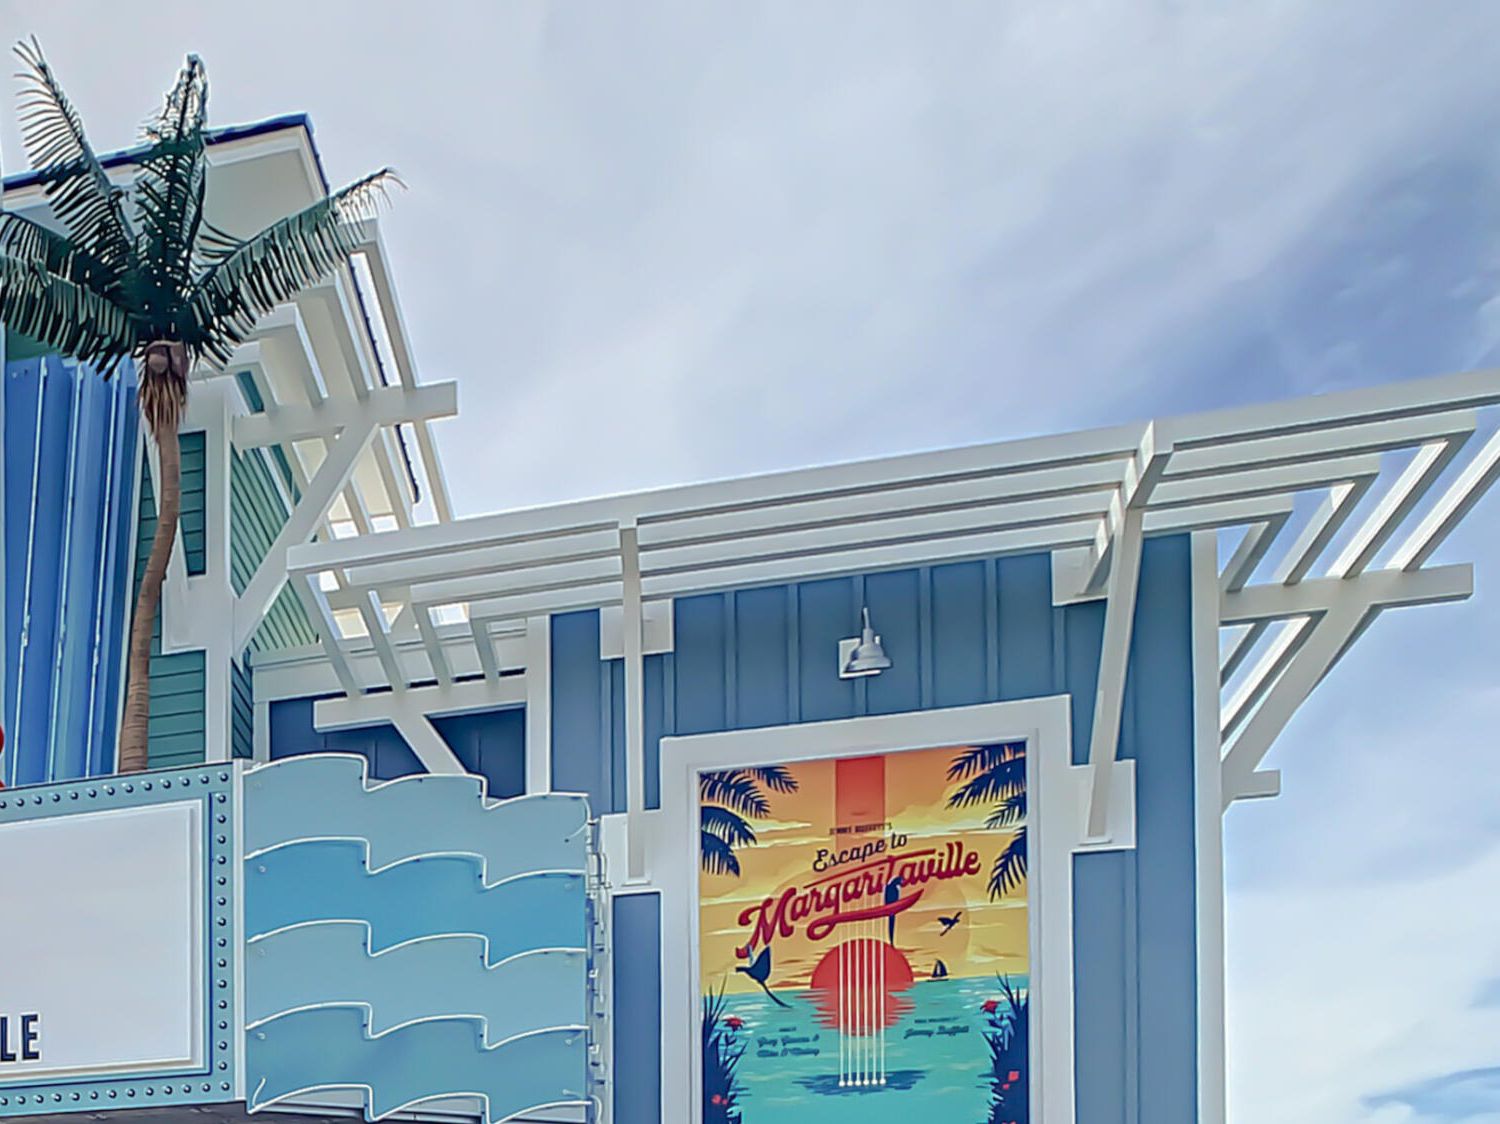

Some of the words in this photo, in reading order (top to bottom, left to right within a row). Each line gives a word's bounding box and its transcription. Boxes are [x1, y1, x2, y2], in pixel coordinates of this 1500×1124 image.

[813, 838, 888, 872] Escape
[891, 832, 908, 849] to
[736, 841, 982, 959] Margaritaville
